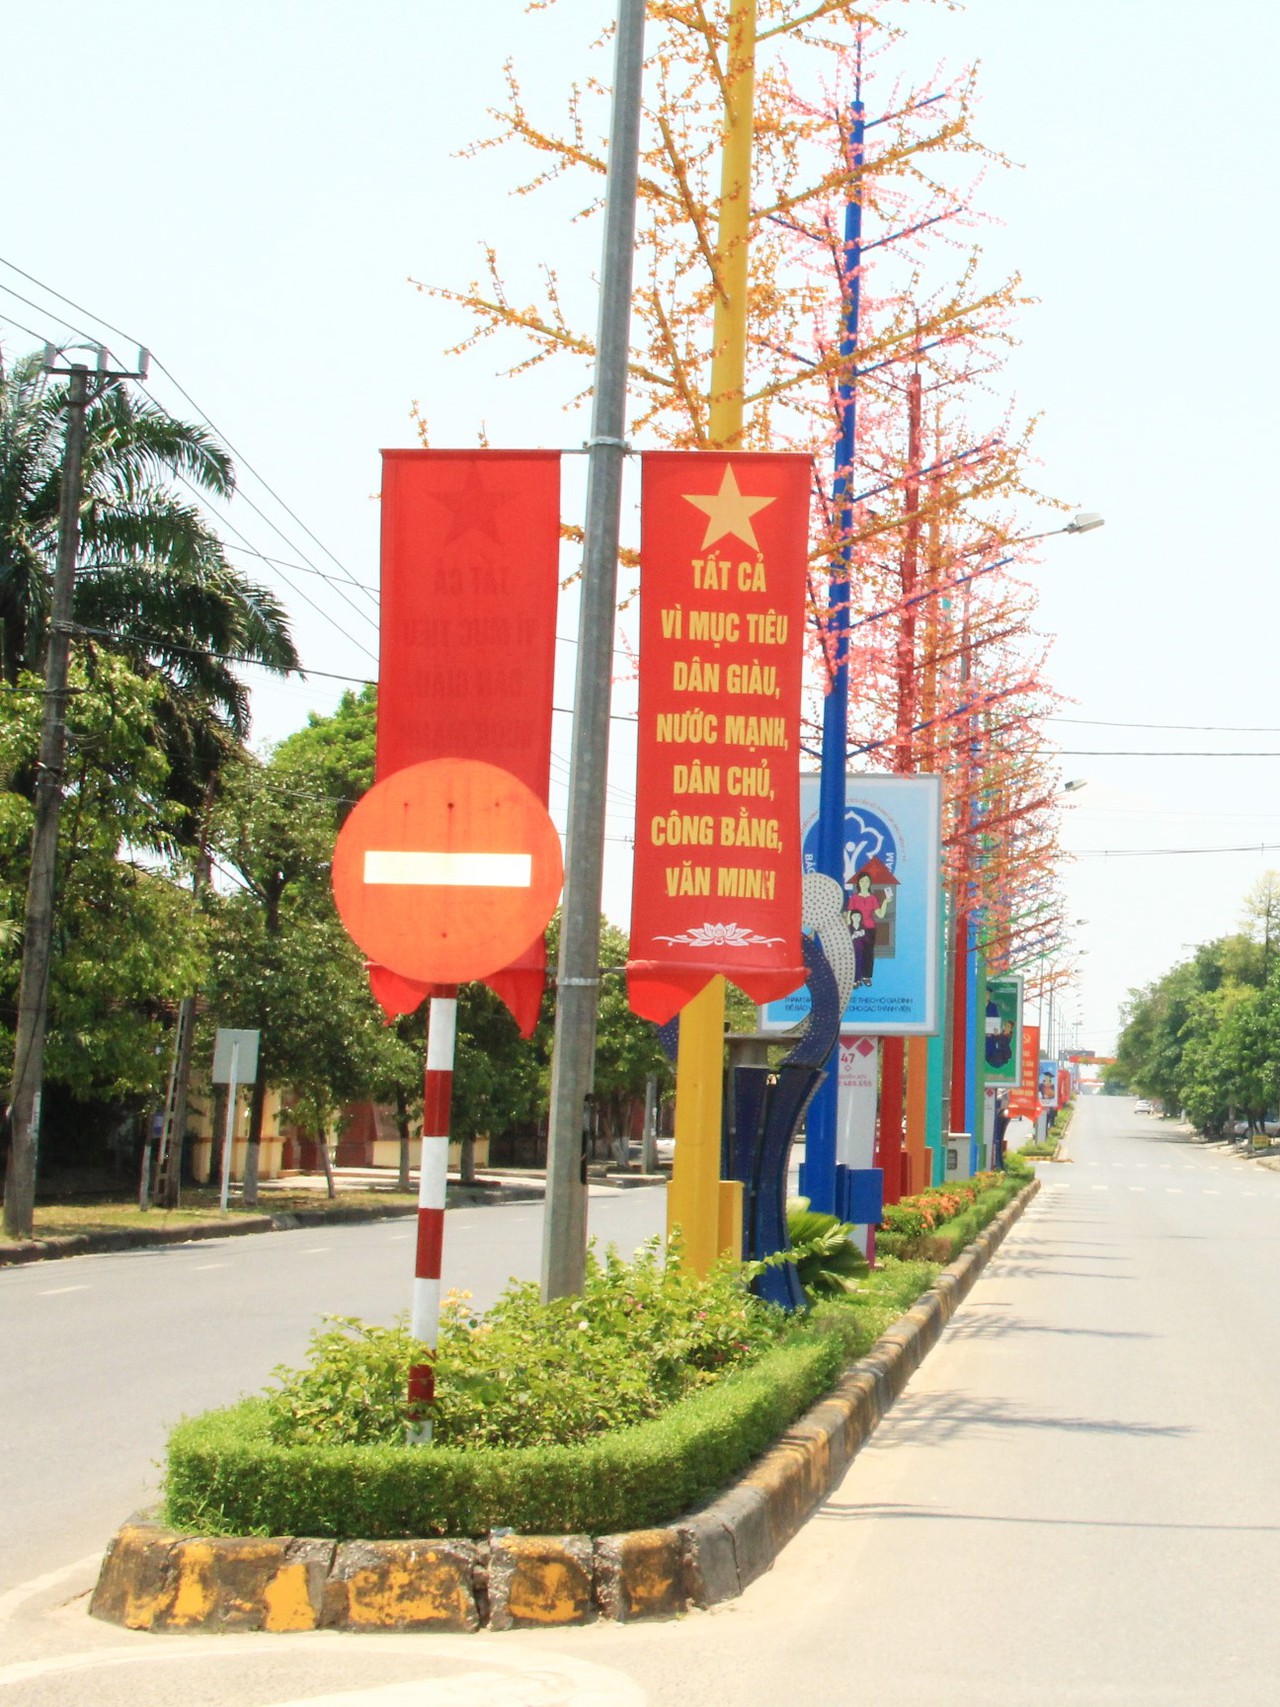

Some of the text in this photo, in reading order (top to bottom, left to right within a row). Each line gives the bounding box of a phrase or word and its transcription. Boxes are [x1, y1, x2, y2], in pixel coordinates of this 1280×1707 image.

[691, 550, 767, 592] TẤT CẢ
[661, 604, 788, 648] VÌ MỤC TIÊU
[673, 656, 780, 700] DÂN GIÀU,
[656, 707, 788, 752] NƯỚC MẠNH,
[673, 759, 775, 801] DÂN CHỦ,
[651, 810, 714, 846] CÔNG
[720, 807, 783, 853] BẰNG,
[665, 860, 776, 900] VĂN MINH
